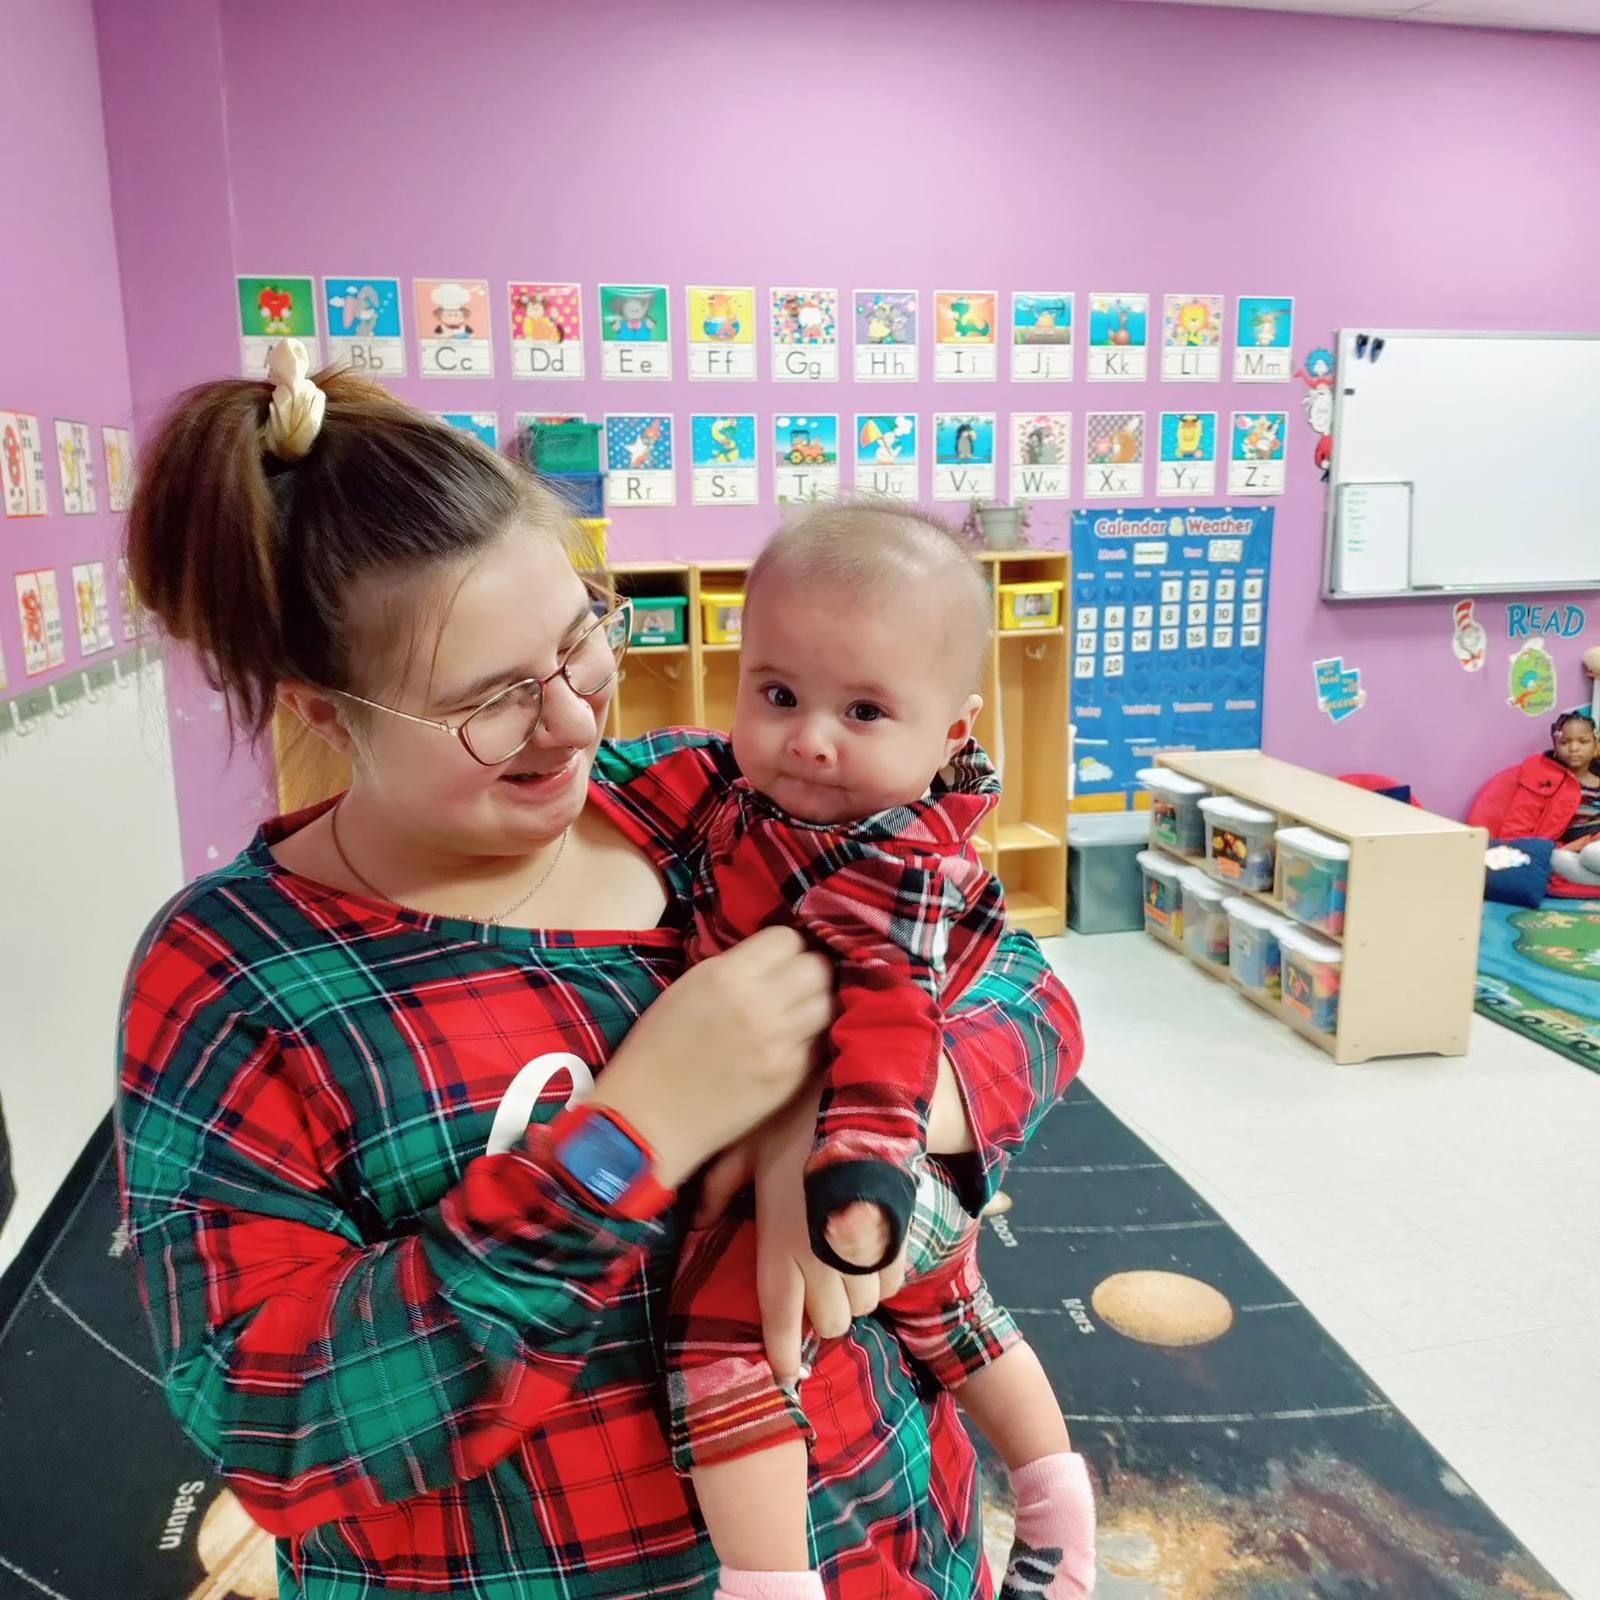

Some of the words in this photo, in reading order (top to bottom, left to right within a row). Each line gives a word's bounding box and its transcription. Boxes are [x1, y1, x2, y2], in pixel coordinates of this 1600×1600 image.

[351, 345, 383, 369] Bb
[435, 346, 472, 371] Cc
[530, 347, 564, 372] Dd
[620, 349, 652, 373] Ee
[708, 350, 733, 374] Ff
[785, 351, 821, 380] Gg
[871, 352, 904, 375] Hh
[1030, 352, 1051, 378] Jj
[1105, 352, 1129, 375] Kk
[1244, 353, 1280, 375] Mm
[950, 471, 978, 492] Vv
[1022, 472, 1060, 493] Ww
[1100, 470, 1127, 492] Xx
[1173, 468, 1199, 491] Yy
[1244, 467, 1270, 487] Zz
[1096, 518, 1165, 536] Calendar
[1186, 517, 1251, 534] Weather
[1217, 608, 1229, 619] 10
[1506, 603, 1585, 638] READ
[1080, 637, 1092, 648] 12
[1135, 635, 1147, 646] 14
[1163, 634, 1174, 644] 15
[1189, 632, 1201, 643] 16
[1216, 632, 1228, 642] 17
[1078, 661, 1090, 672] 19
[1107, 659, 1120, 672] 20
[1062, 1297, 1096, 1334] Mars
[157, 1479, 205, 1551] Saturn
